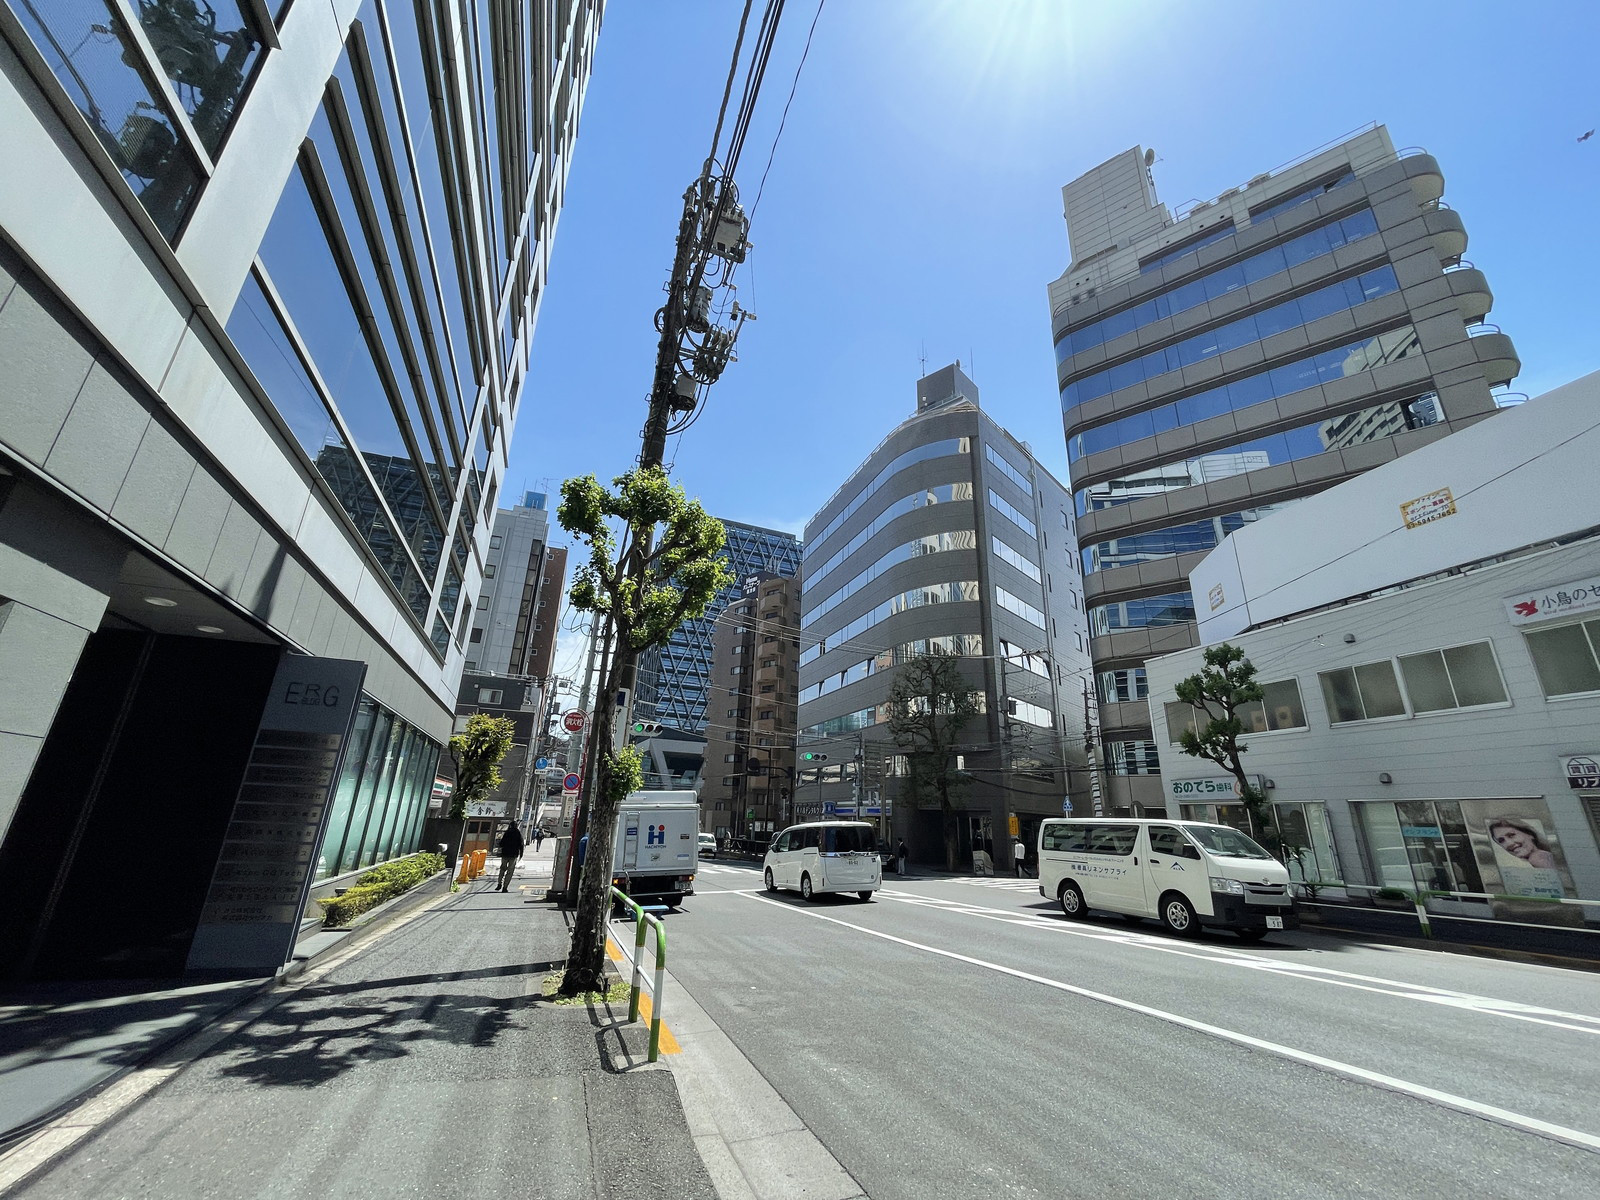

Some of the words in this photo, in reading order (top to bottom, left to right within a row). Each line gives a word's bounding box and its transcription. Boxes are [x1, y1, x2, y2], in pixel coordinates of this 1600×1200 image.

[285, 682, 340, 707] ERG
[565, 717, 584, 727] 消火栓
